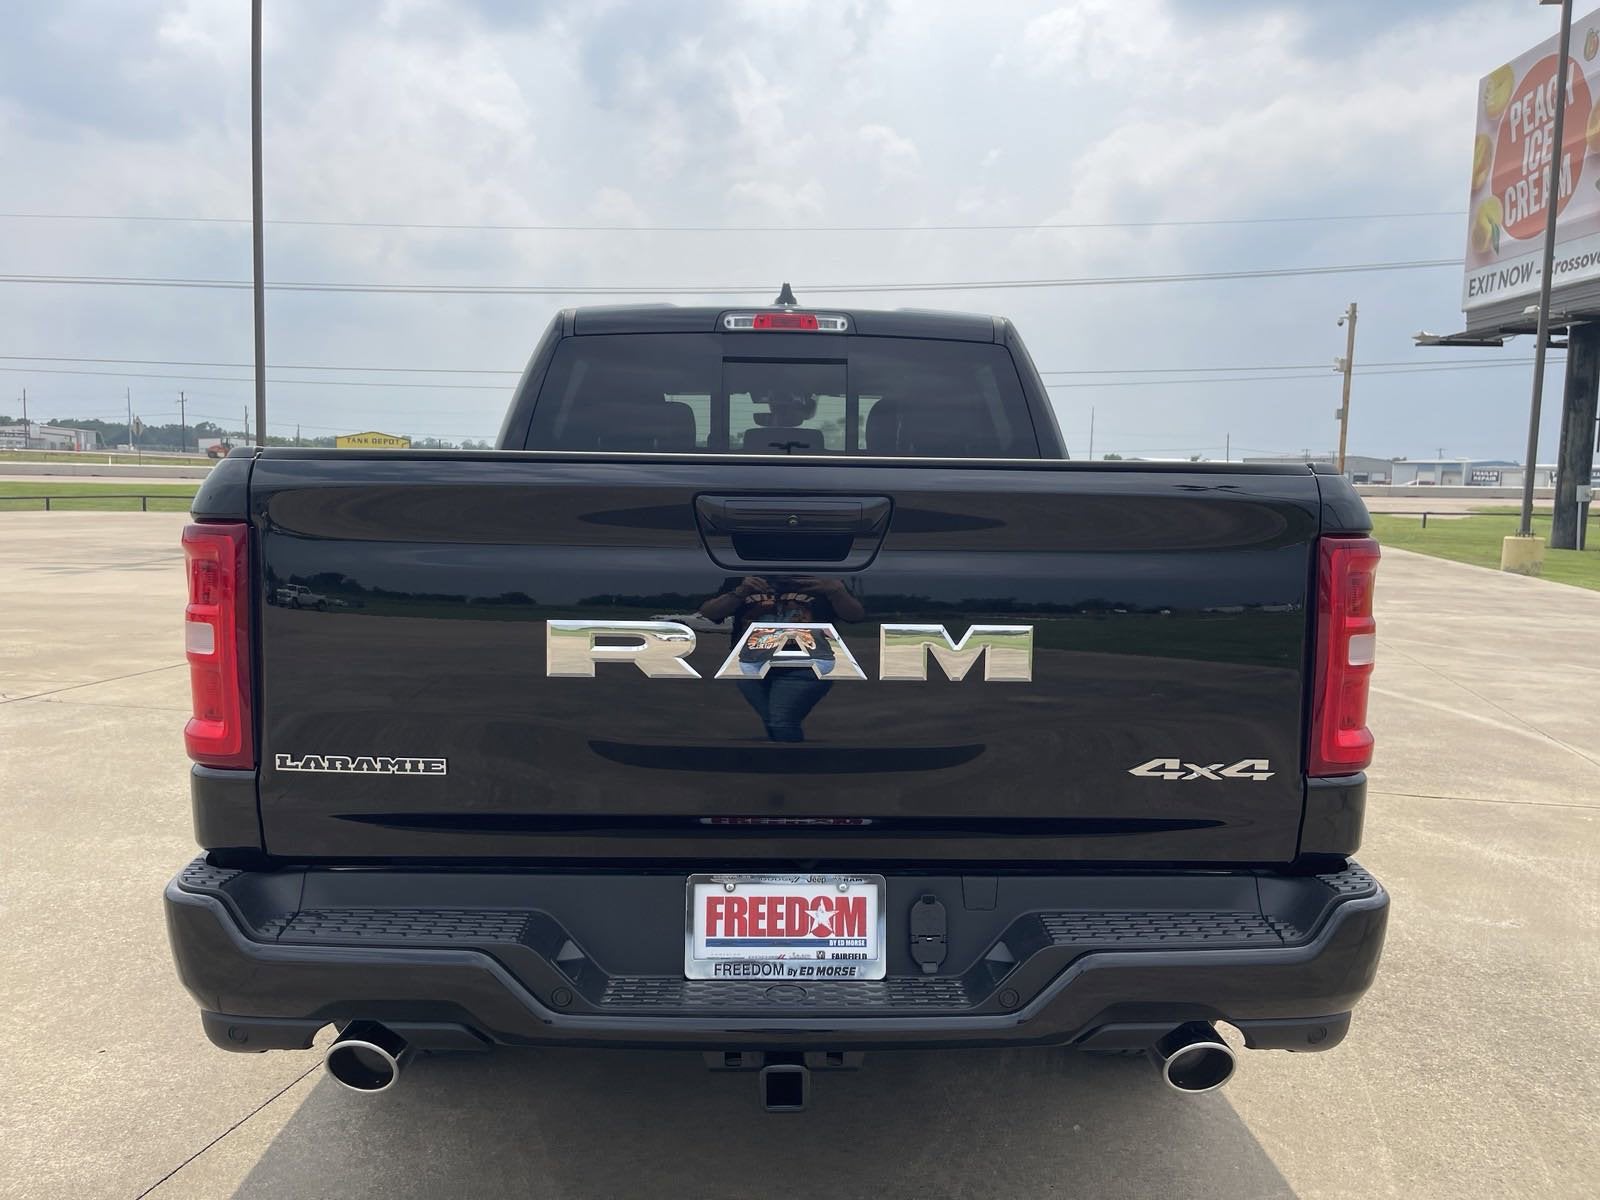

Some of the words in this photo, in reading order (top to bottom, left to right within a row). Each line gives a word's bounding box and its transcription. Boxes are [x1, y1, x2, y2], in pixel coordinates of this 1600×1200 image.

[1522, 121, 1554, 176] ICE
[1504, 153, 1573, 228] CREAM
[1468, 272, 1497, 298] EXIT
[1498, 261, 1534, 289] NOW
[1552, 251, 1600, 276] rossov
[371, 437, 399, 445] DEPOT
[546, 619, 1034, 682] RAM
[275, 753, 447, 776] LARAMIE
[1127, 758, 1276, 781] 4x4
[806, 875, 827, 883] Jeep
[706, 895, 867, 938] FREEDOM
[714, 963, 784, 976] FREEDOM
[799, 966, 814, 976] ED
[815, 966, 856, 976] MORSE
